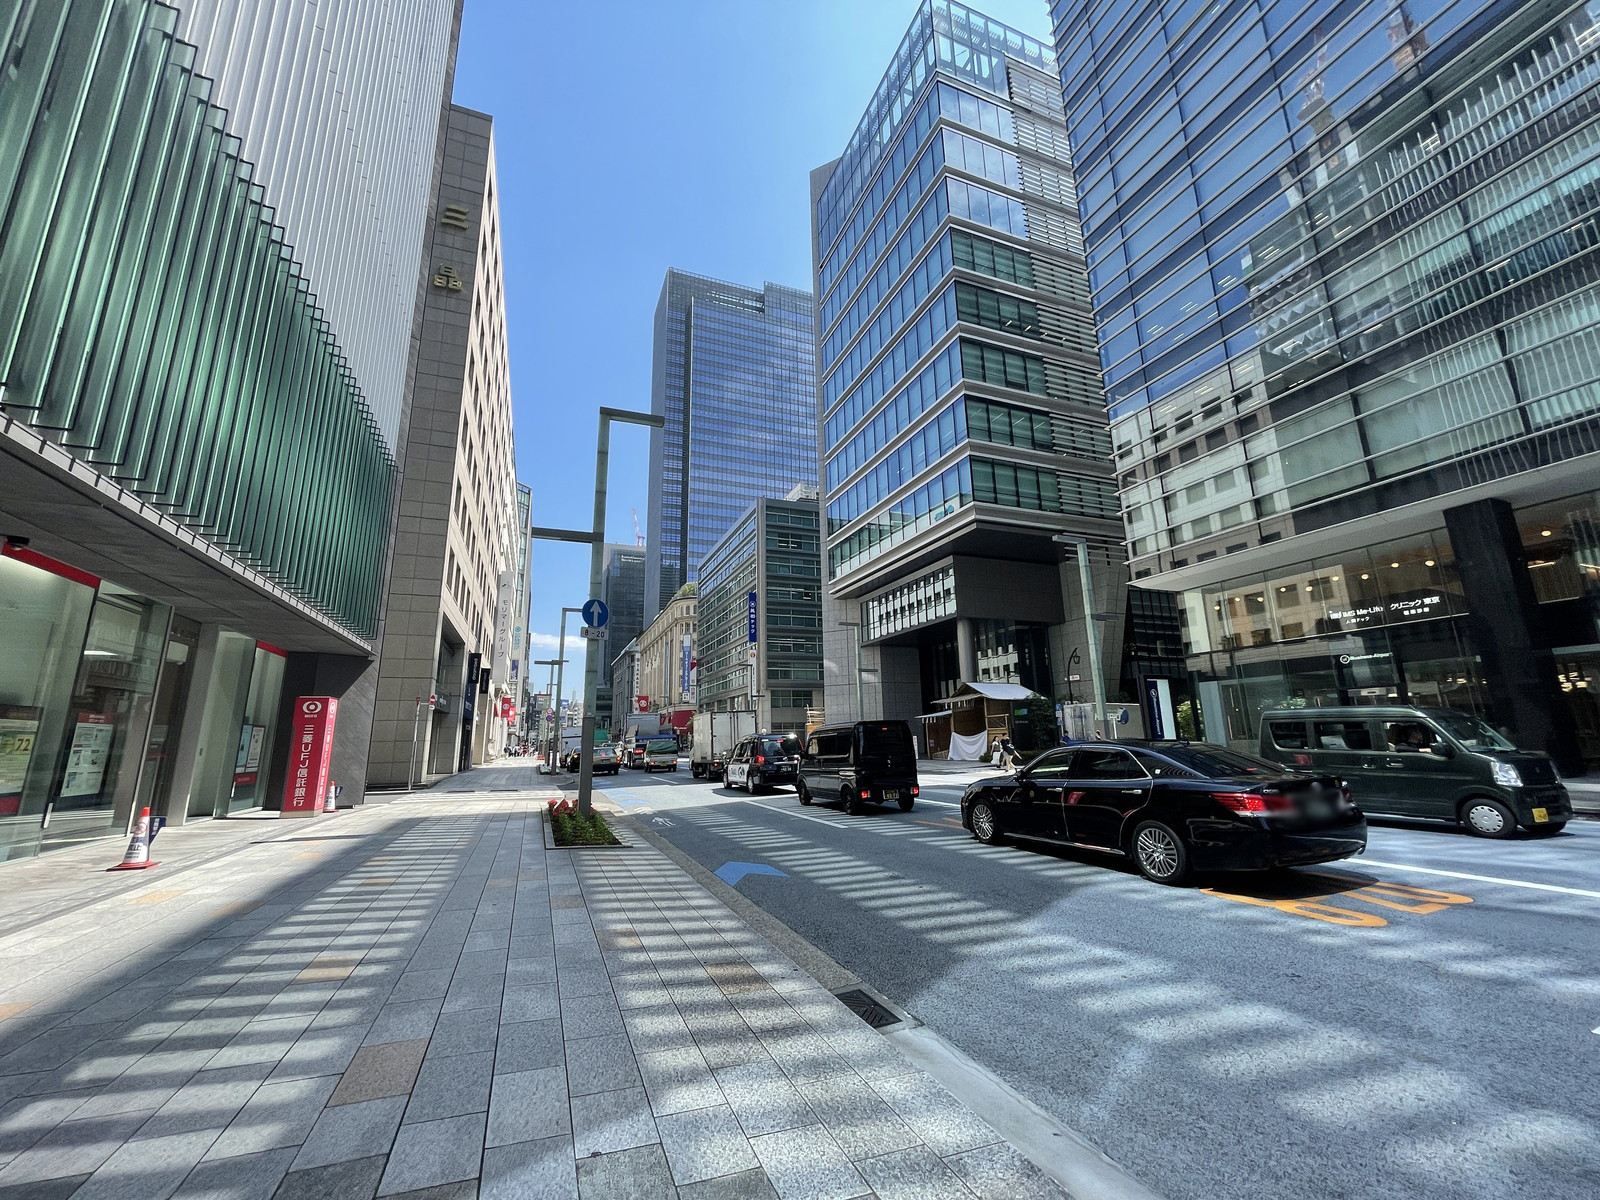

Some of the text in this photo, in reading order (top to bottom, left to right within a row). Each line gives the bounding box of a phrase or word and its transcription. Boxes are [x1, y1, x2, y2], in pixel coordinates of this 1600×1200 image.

[293, 724, 315, 807] 三菱UFJ信託銀行
